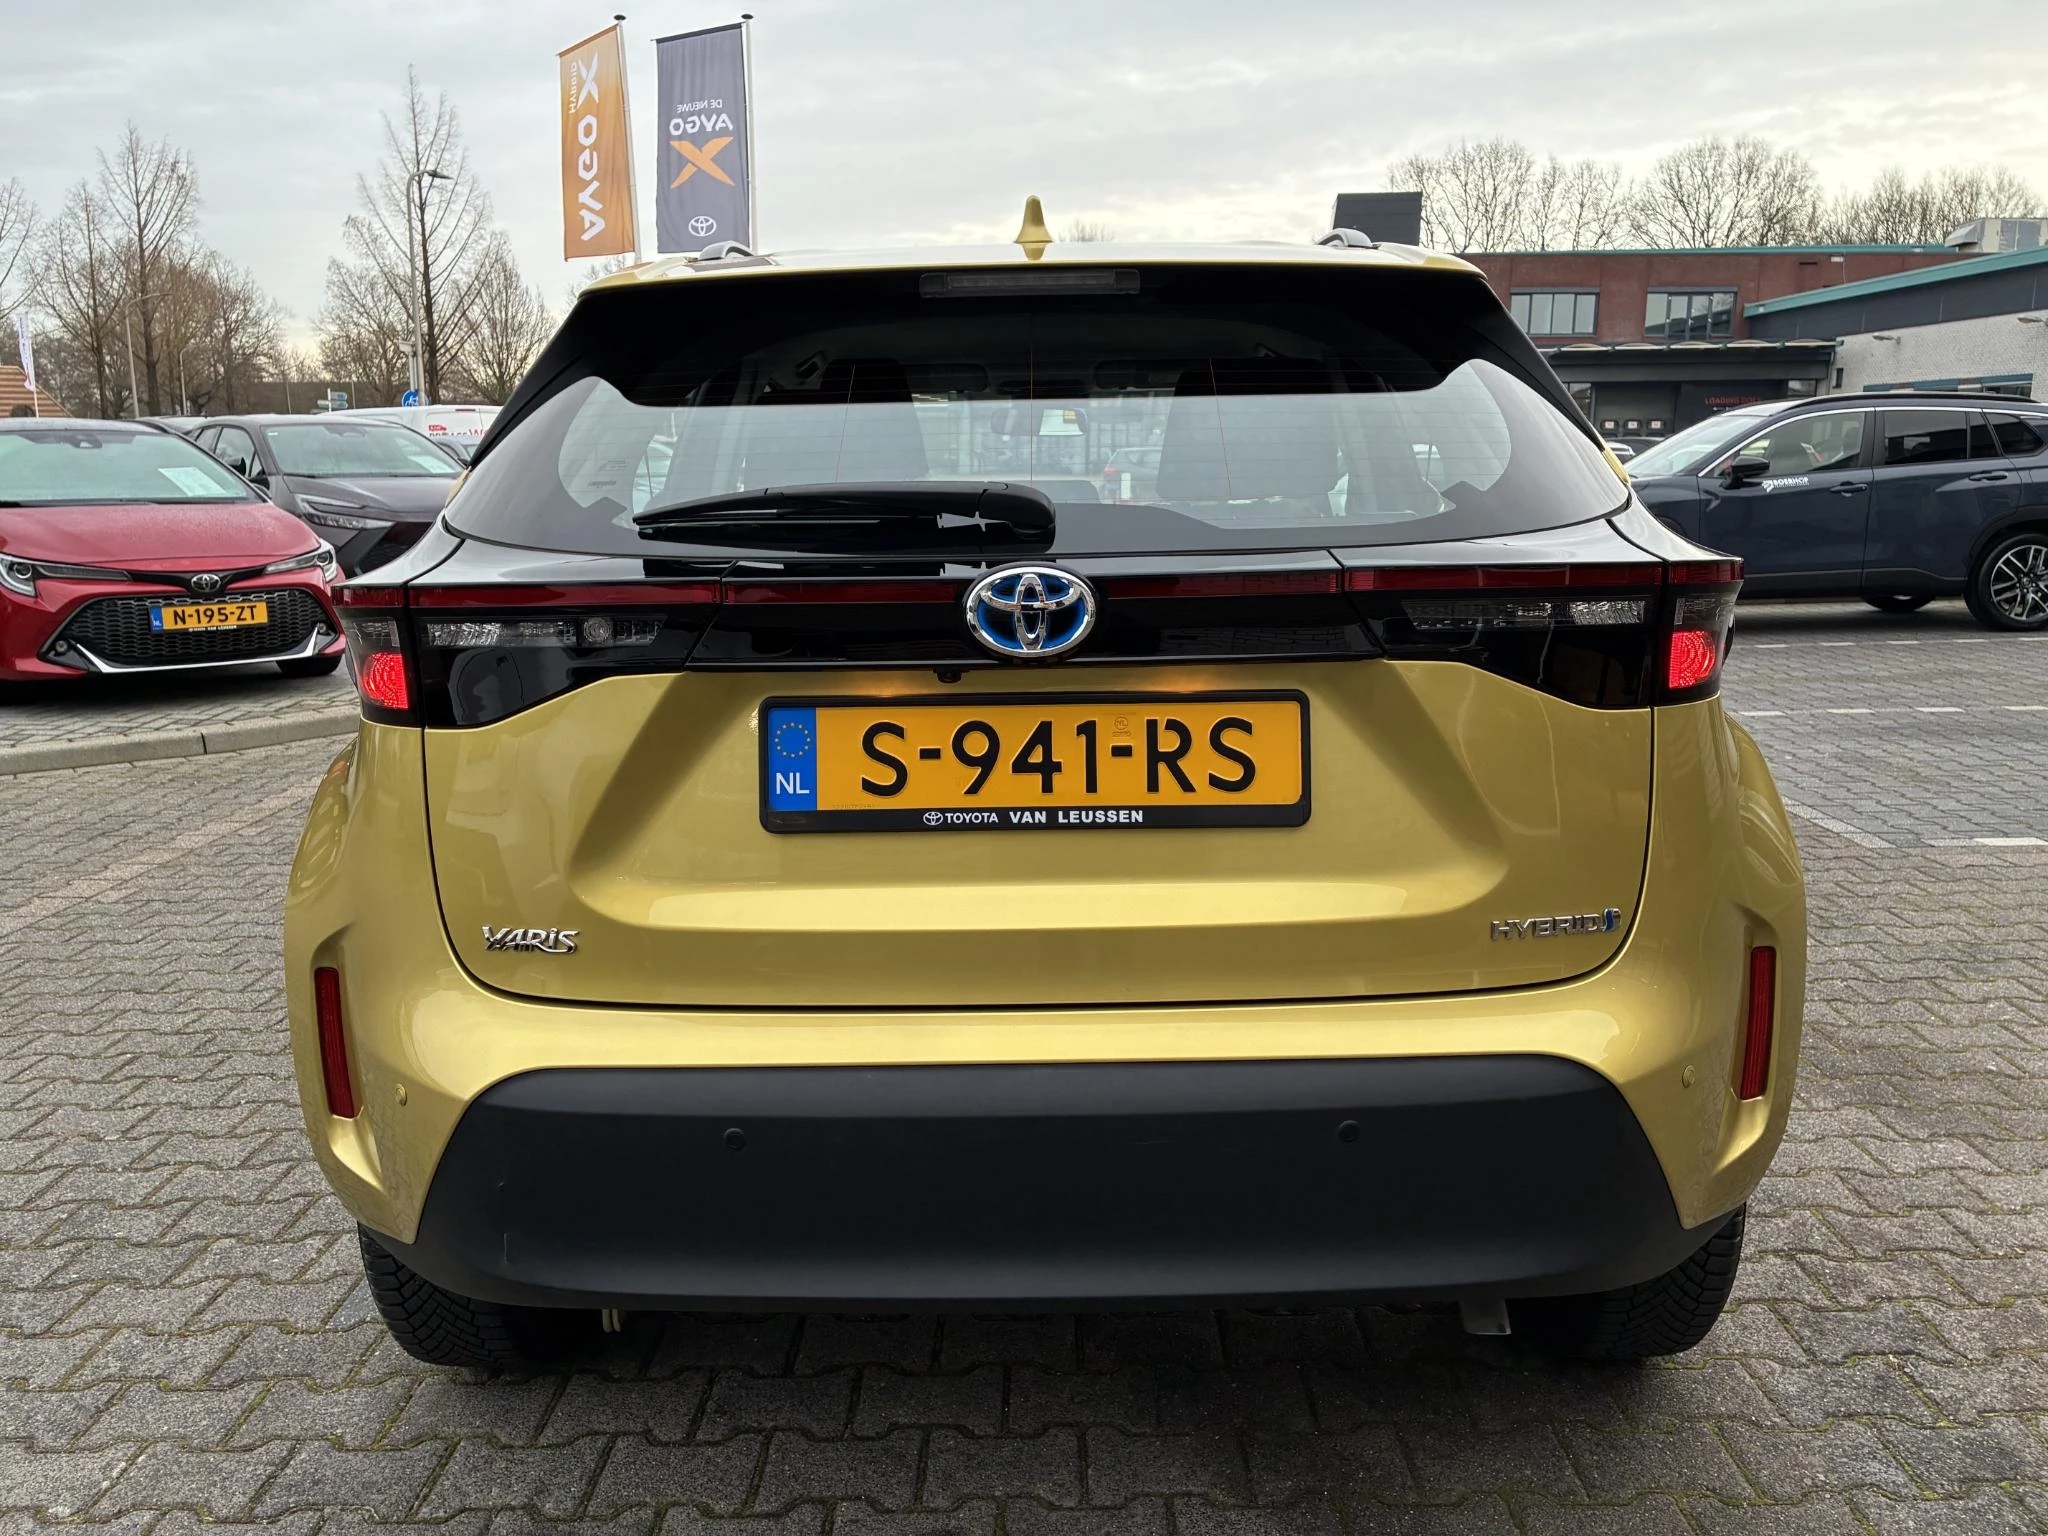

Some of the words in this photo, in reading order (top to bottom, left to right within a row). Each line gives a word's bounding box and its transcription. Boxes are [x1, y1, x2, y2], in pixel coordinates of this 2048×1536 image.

[173, 605, 257, 626] N-195-ZT
[861, 716, 1257, 797] S-941-RS
[775, 772, 811, 795] NL
[945, 812, 999, 824] TOYOTA
[1009, 811, 1047, 824] VAN
[1058, 810, 1144, 824] LEUSSEN
[1490, 913, 1601, 940] HYBRID
